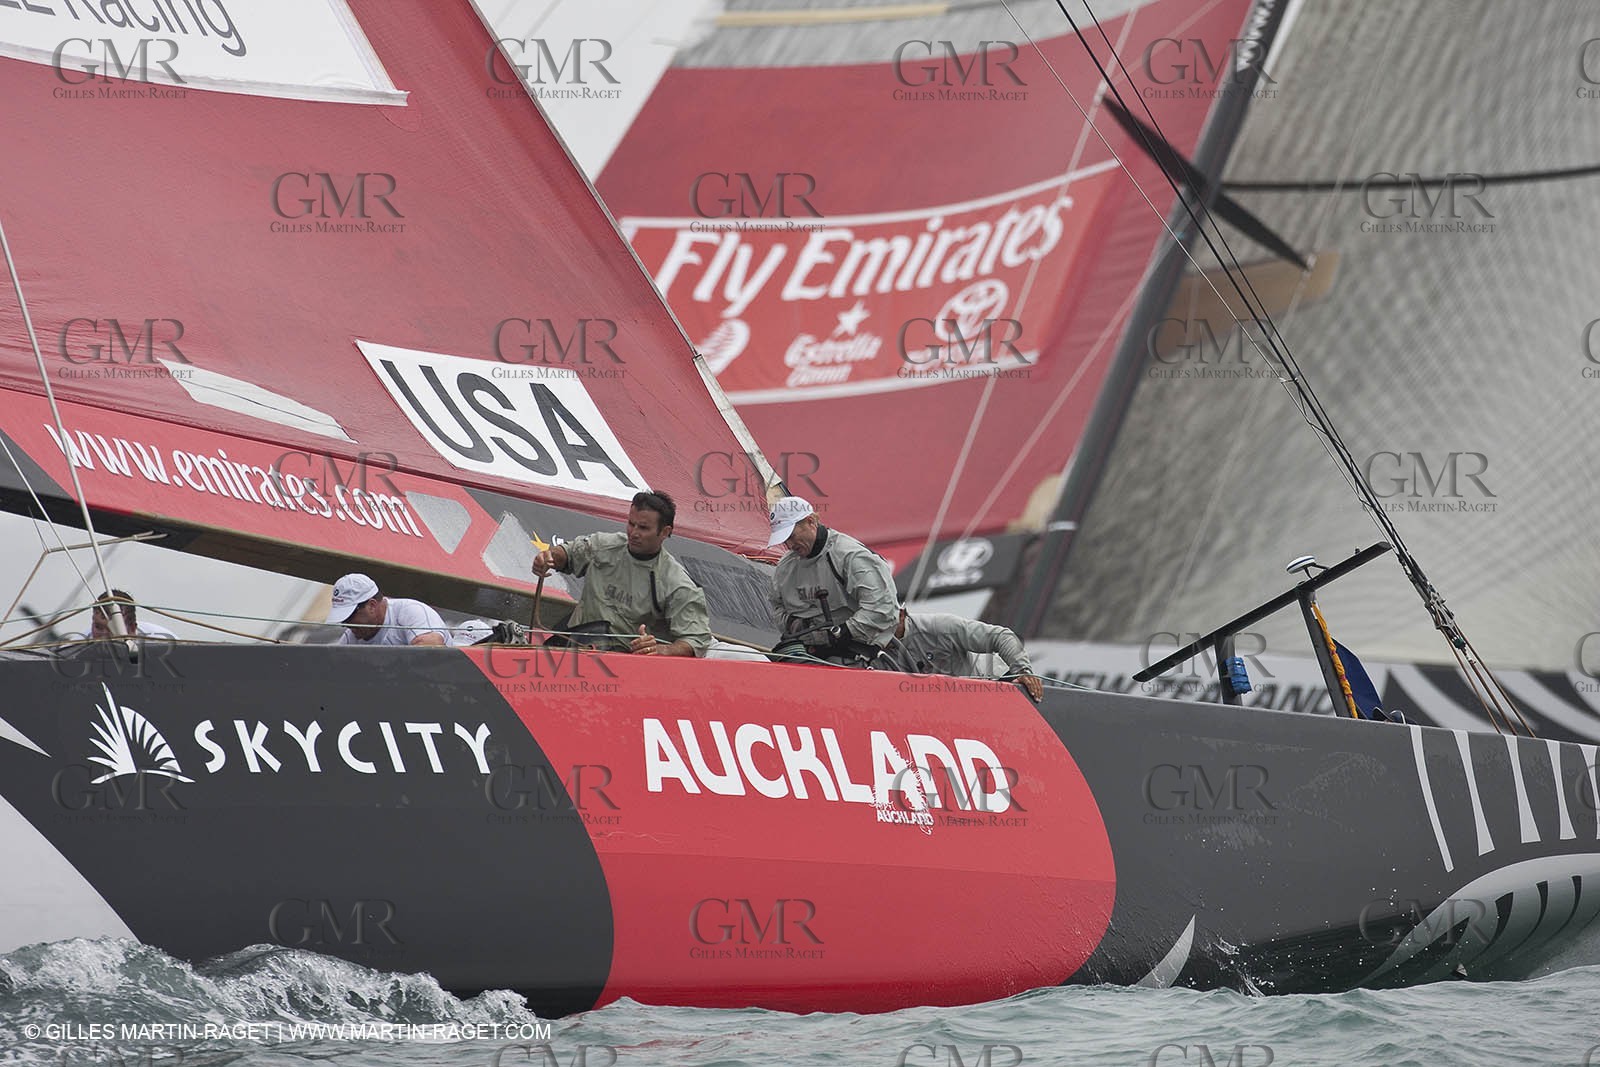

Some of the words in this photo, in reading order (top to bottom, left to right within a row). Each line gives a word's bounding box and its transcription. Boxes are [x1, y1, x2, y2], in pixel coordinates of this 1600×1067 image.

[655, 228, 788, 319] Fly
[780, 196, 1074, 302] Emirates
[43, 423, 424, 538] www.emirates.com
[379, 359, 639, 490] USA
[194, 719, 492, 775] SKYCITY
[642, 718, 1011, 813] AUCKLAND
